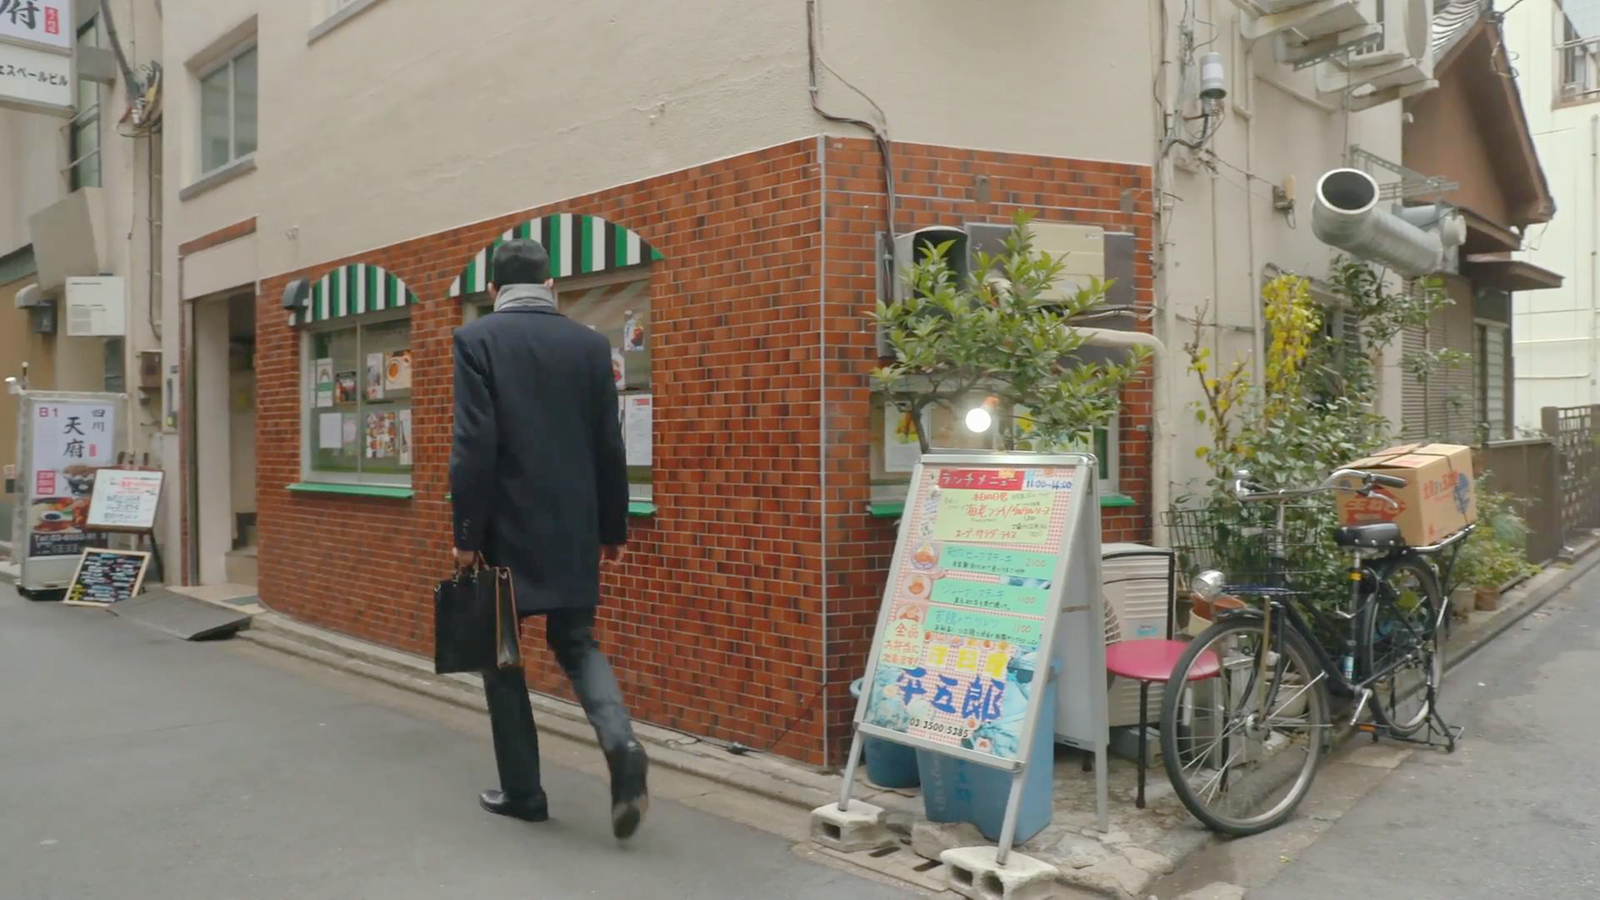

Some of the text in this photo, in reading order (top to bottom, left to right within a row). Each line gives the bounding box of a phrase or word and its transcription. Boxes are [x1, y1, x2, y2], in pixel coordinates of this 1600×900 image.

[91, 408, 106, 432] 四川
[63, 416, 85, 458] 天府
[942, 472, 1018, 487] ランチメニュー
[895, 622, 919, 639] 全品
[897, 667, 1005, 722] 平五郎
[909, 717, 969, 738] 03 3500 5385
